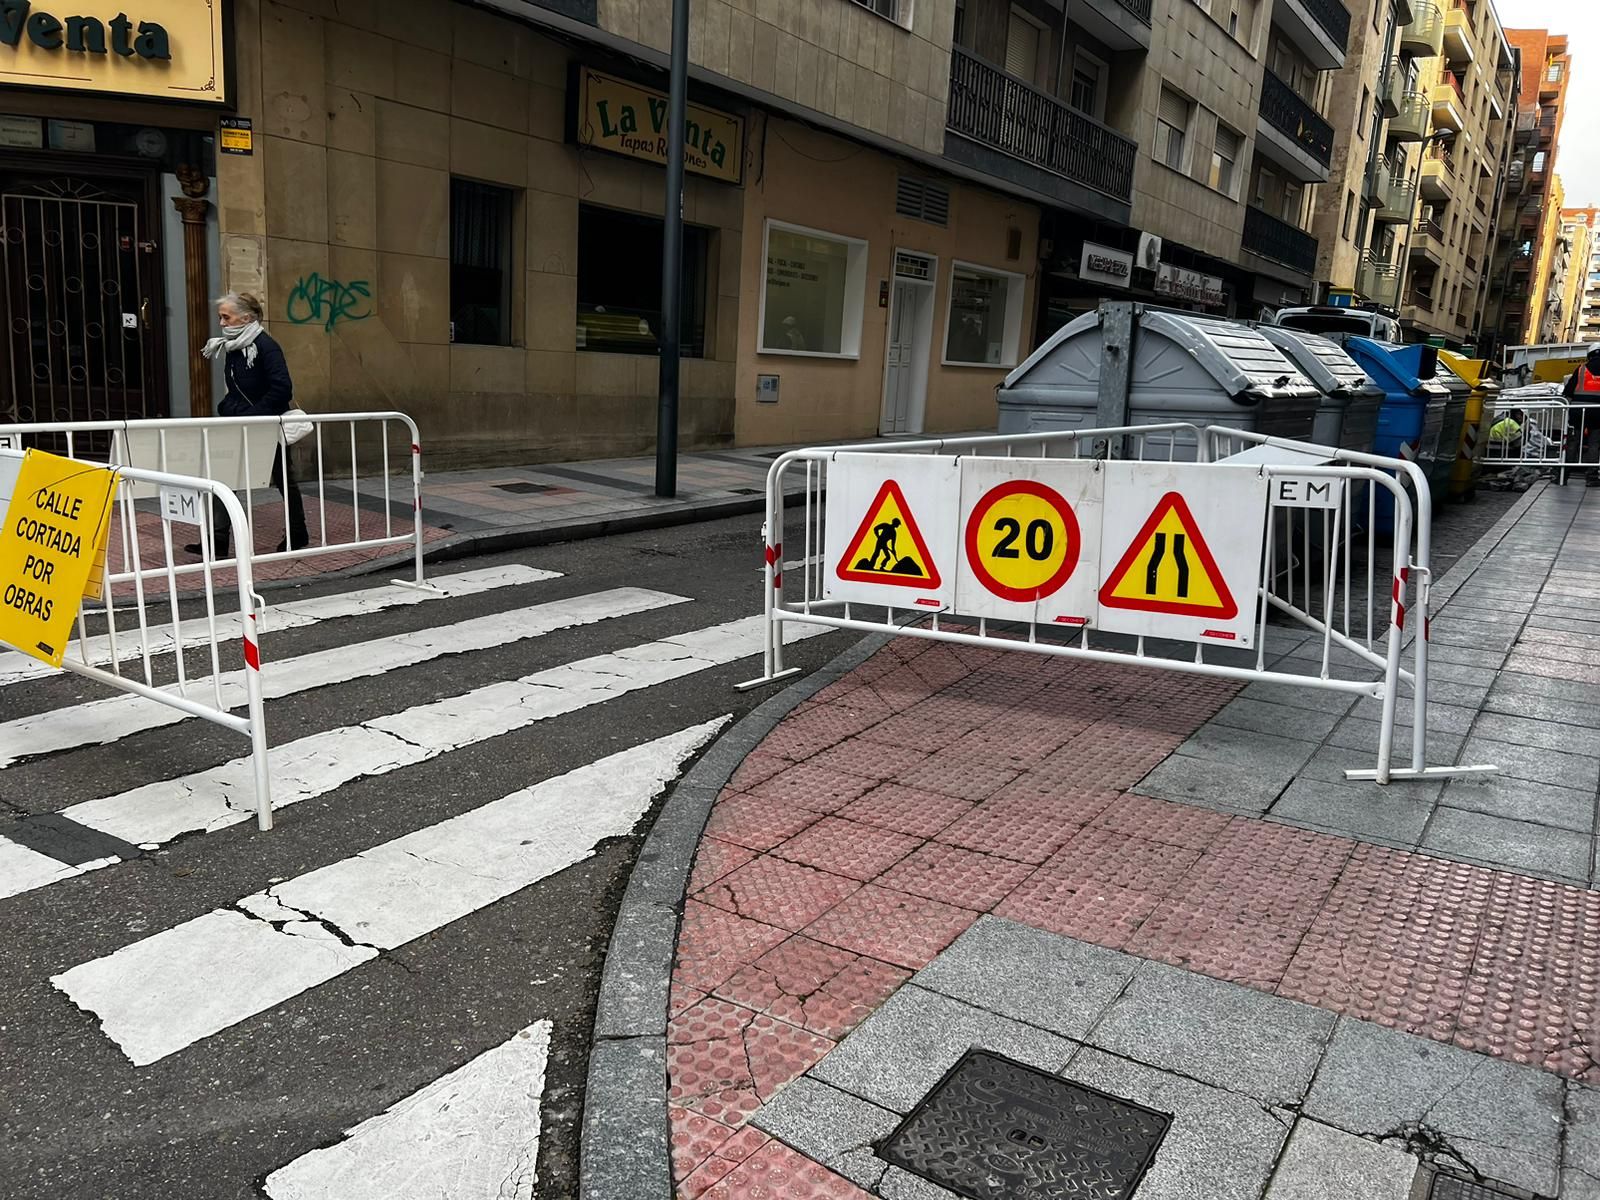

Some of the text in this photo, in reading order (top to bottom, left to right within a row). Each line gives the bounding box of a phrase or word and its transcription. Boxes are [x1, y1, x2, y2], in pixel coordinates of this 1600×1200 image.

[0, 0, 171, 60] Venta
[597, 97, 726, 169] La Vnta
[620, 133, 654, 154] Tapas
[36, 488, 83, 521] CALLE
[168, 494, 195, 518] EM
[1279, 480, 1331, 503] EM
[17, 517, 81, 558] CORTADA
[991, 517, 1054, 561] 20
[23, 555, 54, 585] POR
[4, 584, 54, 622] OBRAS
